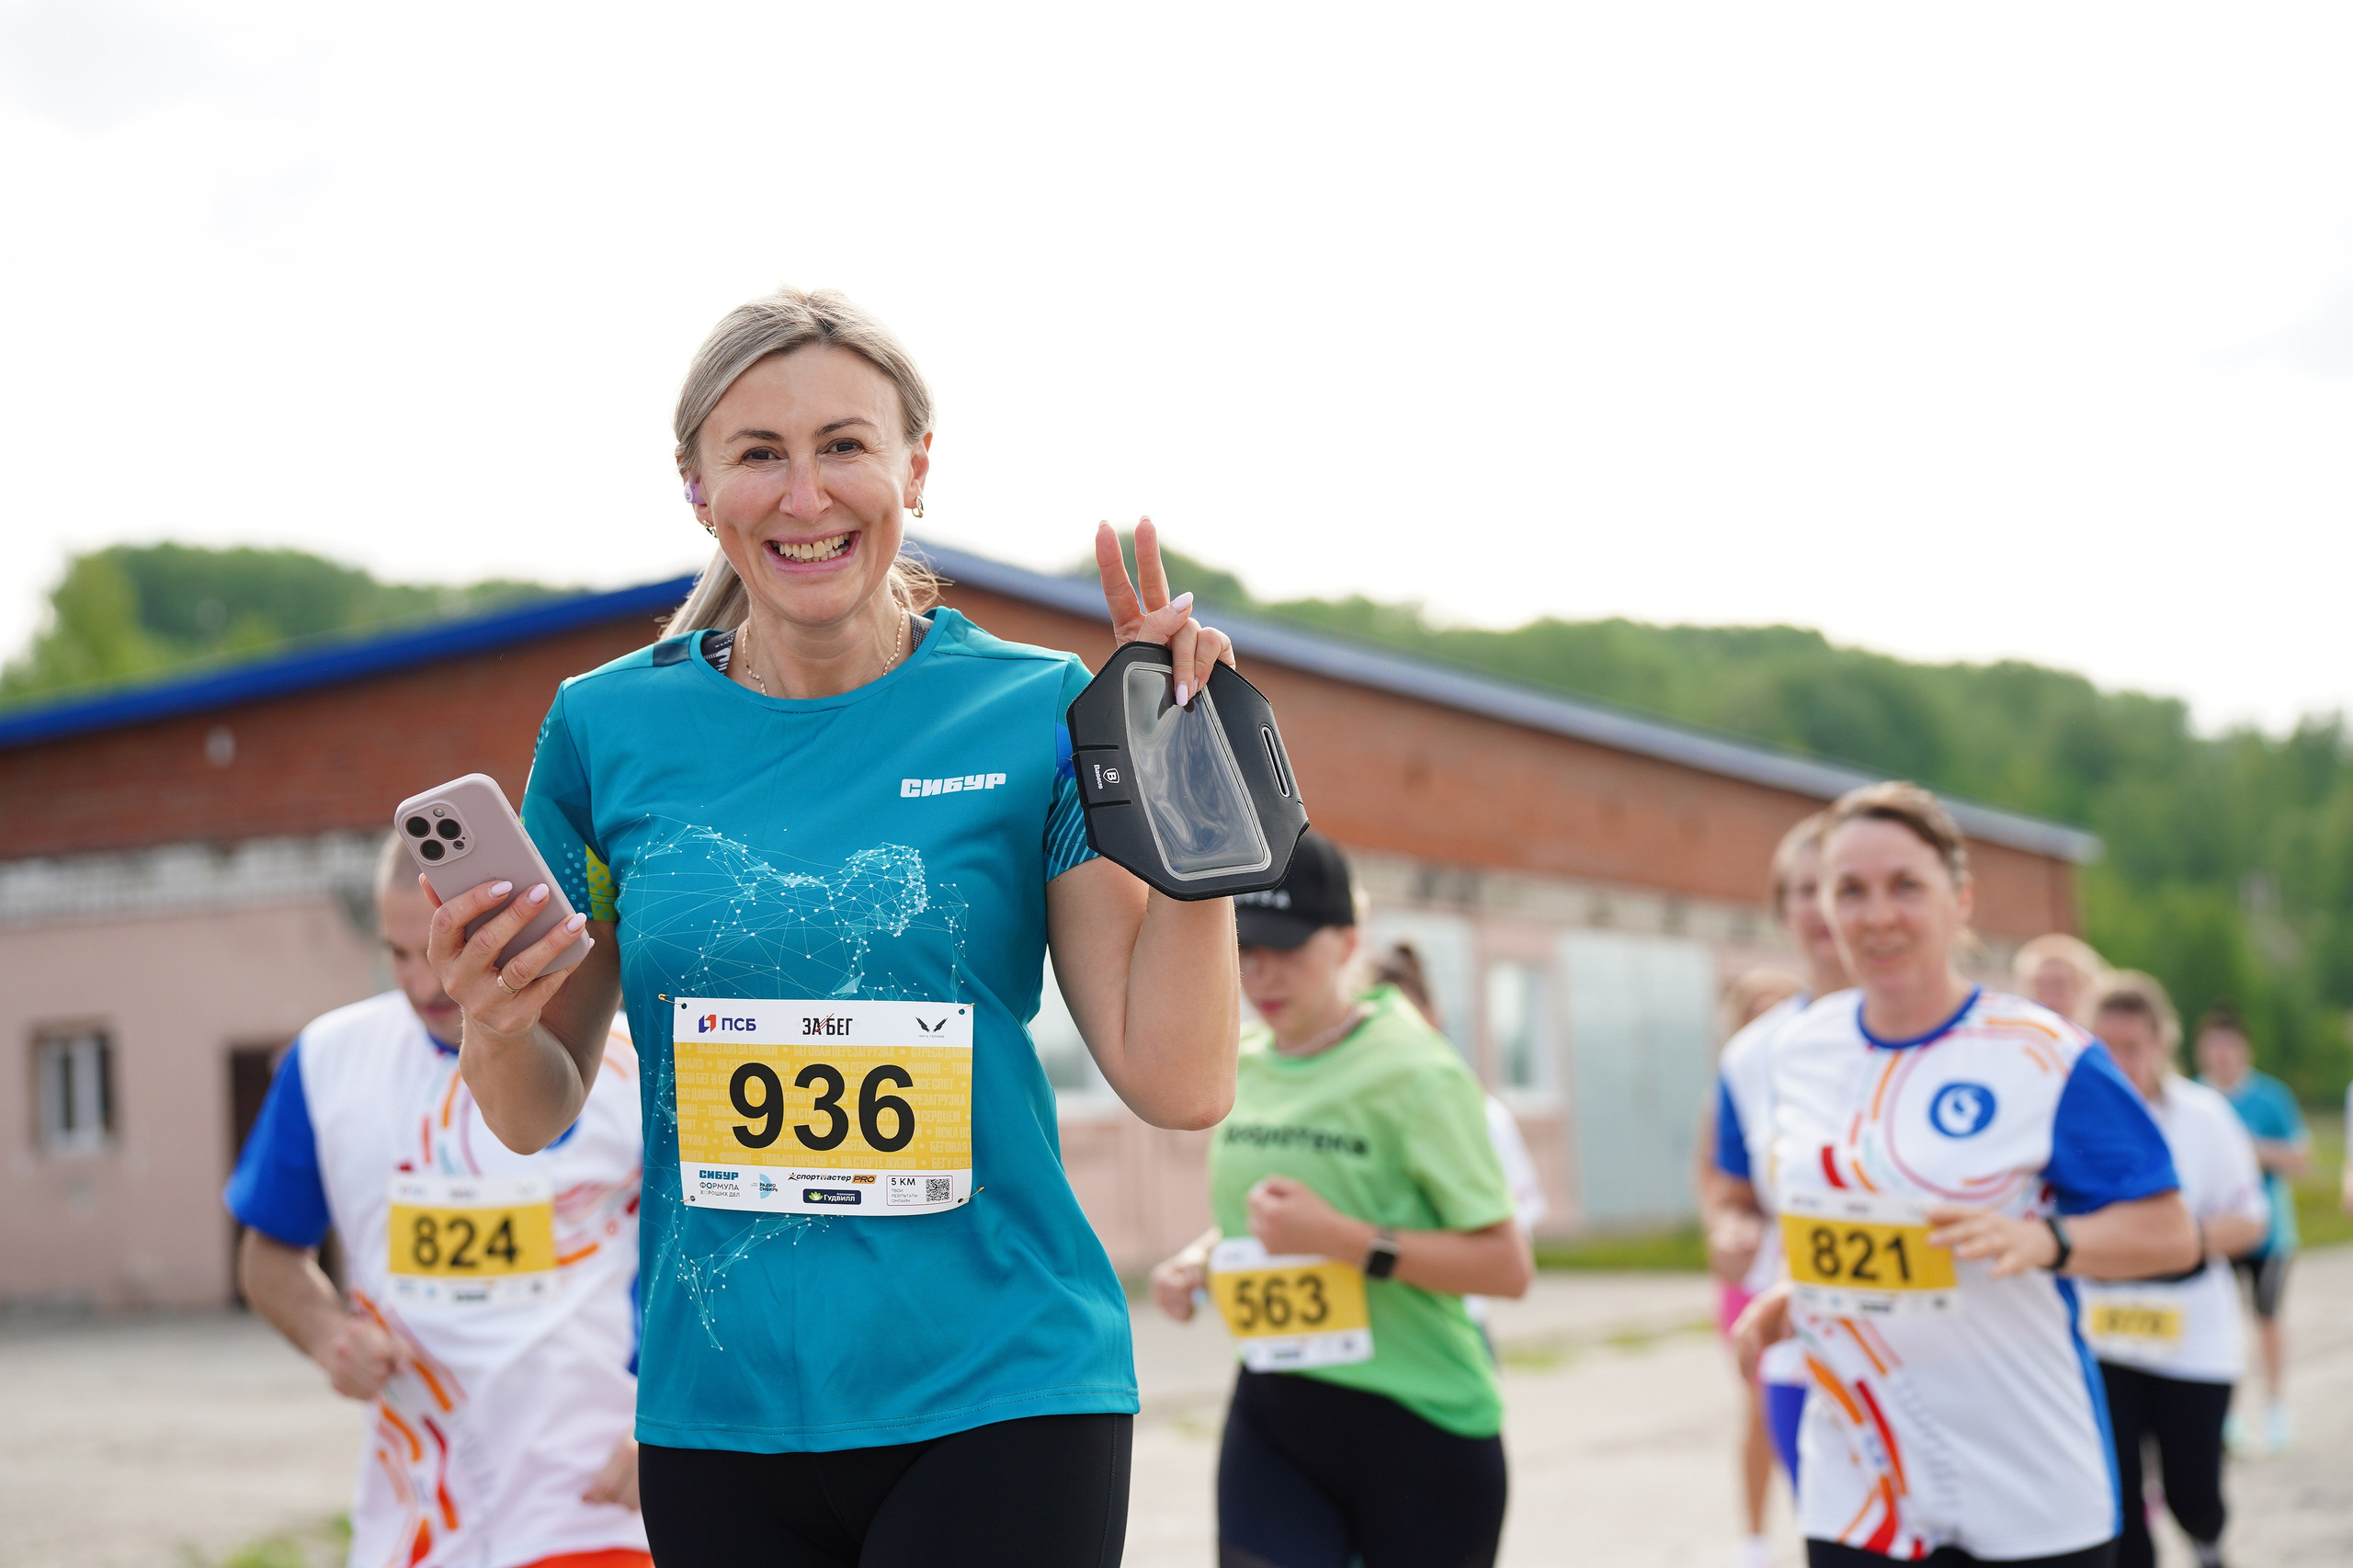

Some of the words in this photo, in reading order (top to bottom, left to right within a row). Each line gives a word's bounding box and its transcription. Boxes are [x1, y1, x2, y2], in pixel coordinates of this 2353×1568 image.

[900, 773, 1006, 798] СИБУР
[1094, 764, 1103, 789] Baseus
[722, 1017, 756, 1031] ПСБ
[729, 1062, 915, 1153] 936
[699, 1170, 739, 1180] СИБУР
[699, 1182, 739, 1191] ФОРМУЛА
[412, 1213, 519, 1269] 824
[1809, 1226, 1913, 1284] 821
[1233, 1274, 1330, 1331] 563
